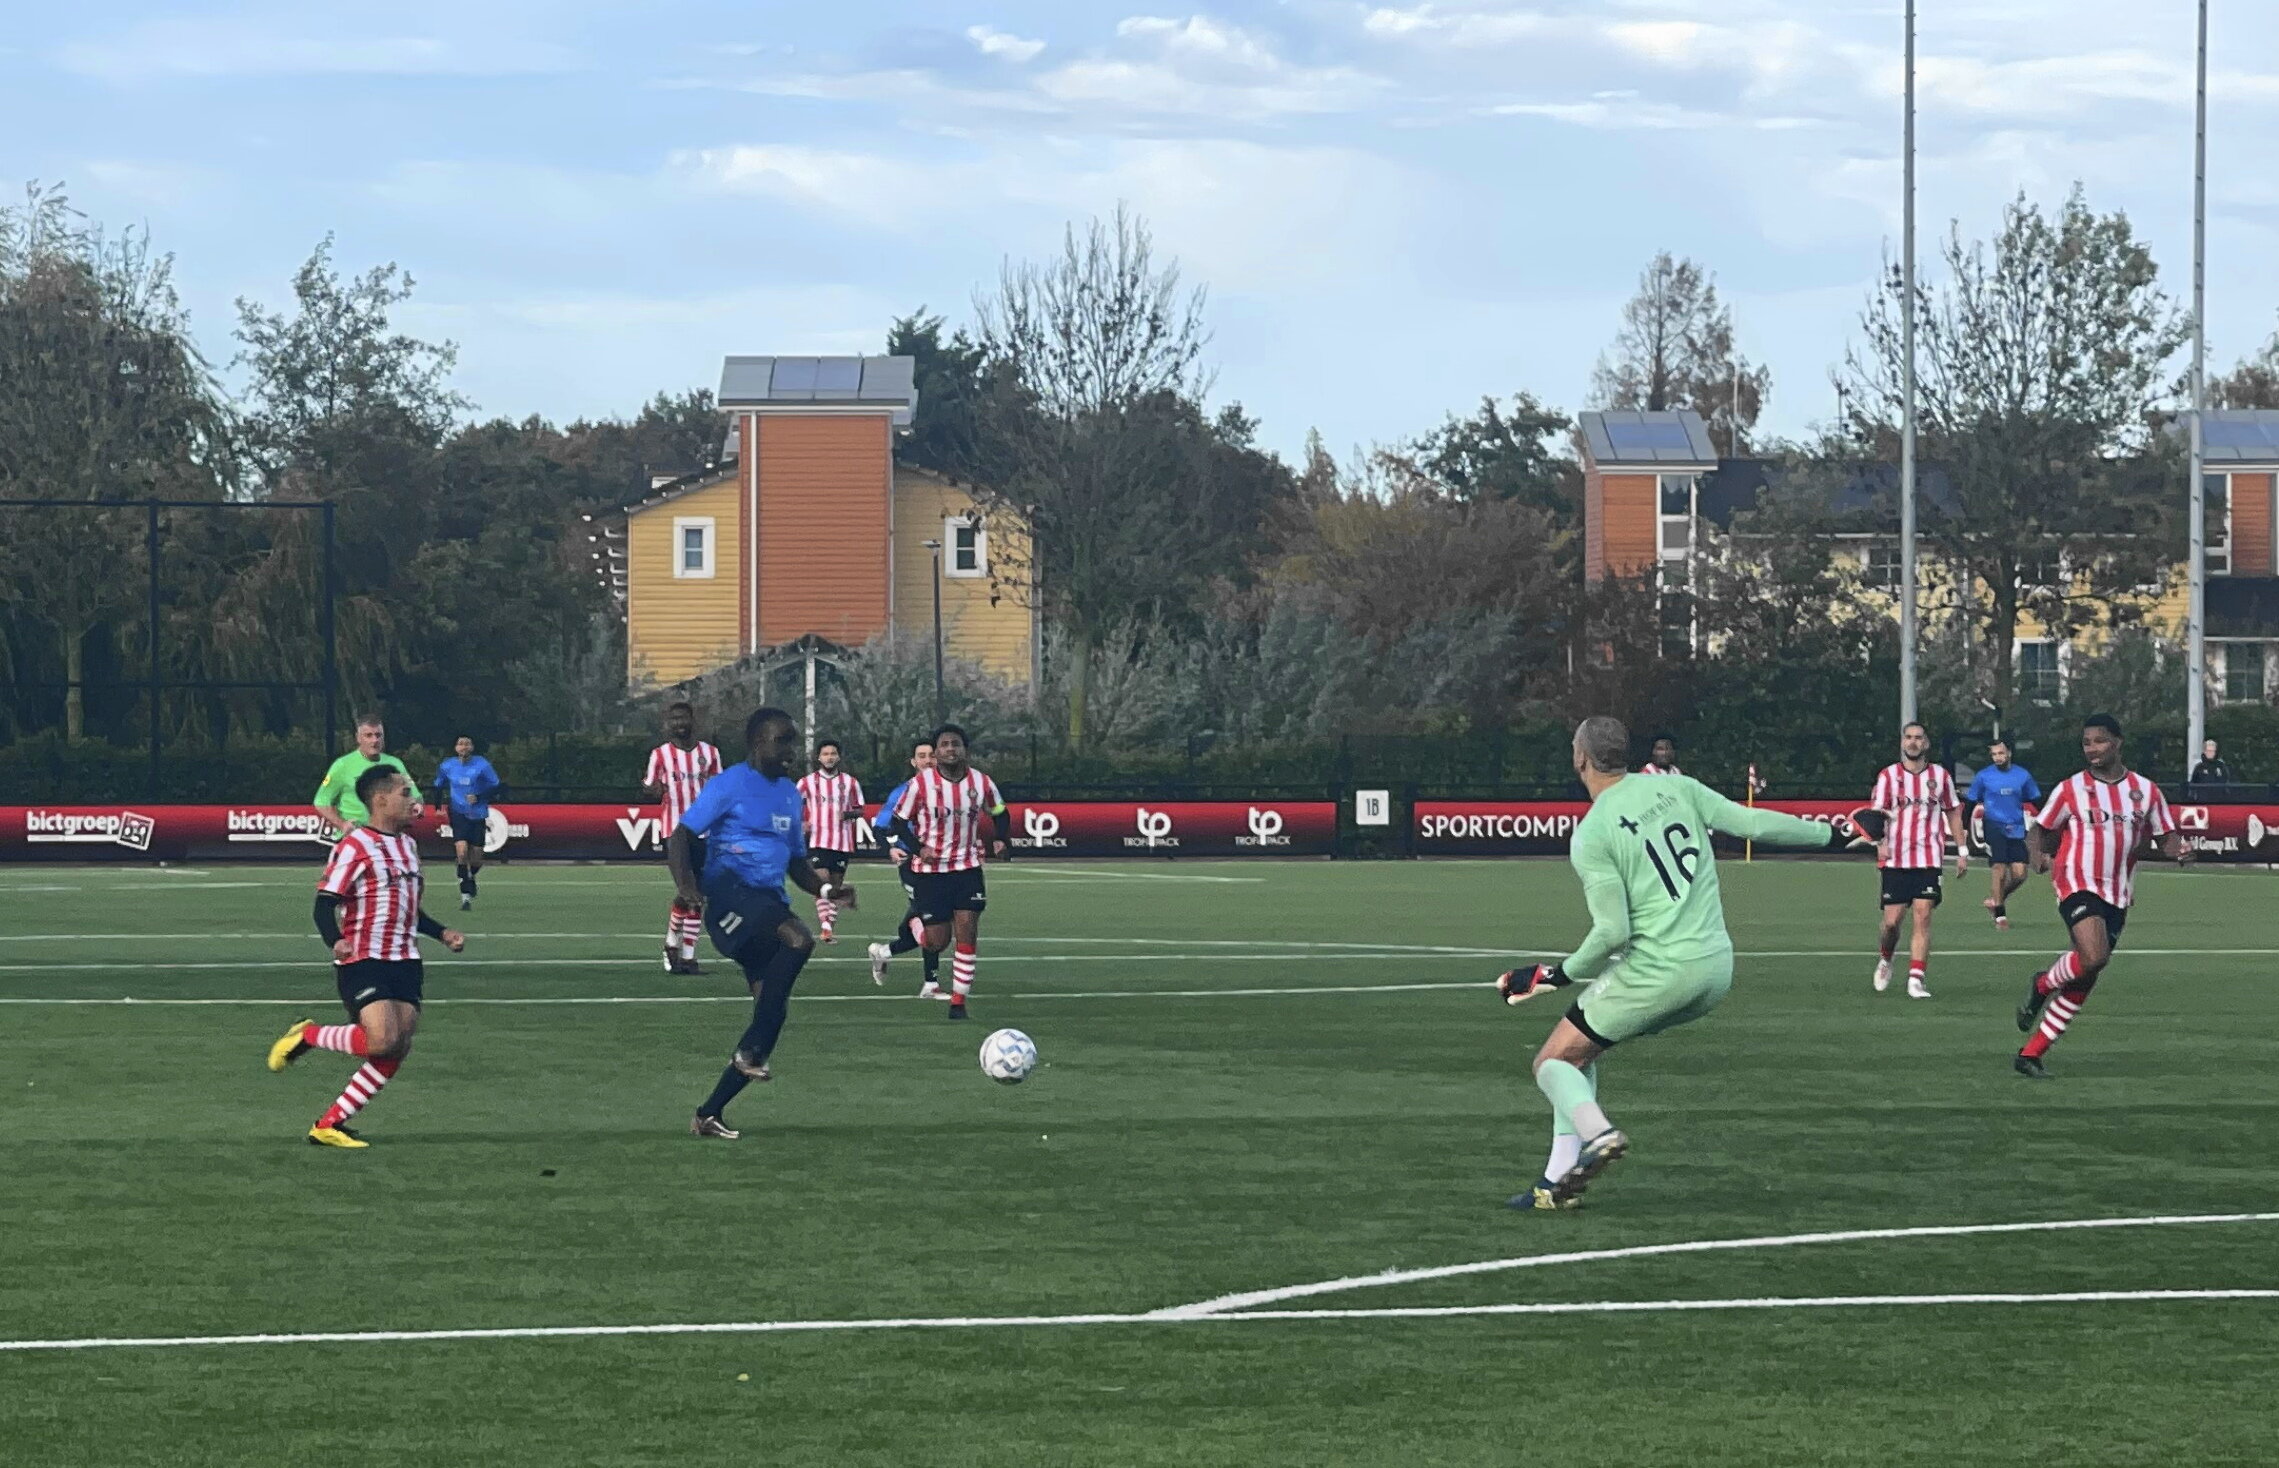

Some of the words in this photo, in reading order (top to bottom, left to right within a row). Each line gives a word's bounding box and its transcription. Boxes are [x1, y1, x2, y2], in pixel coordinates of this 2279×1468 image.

[1365, 798, 1380, 817] 1B
[26, 810, 120, 834] bictgroep
[227, 810, 319, 834] bictgroep
[1645, 822, 1700, 902] 16
